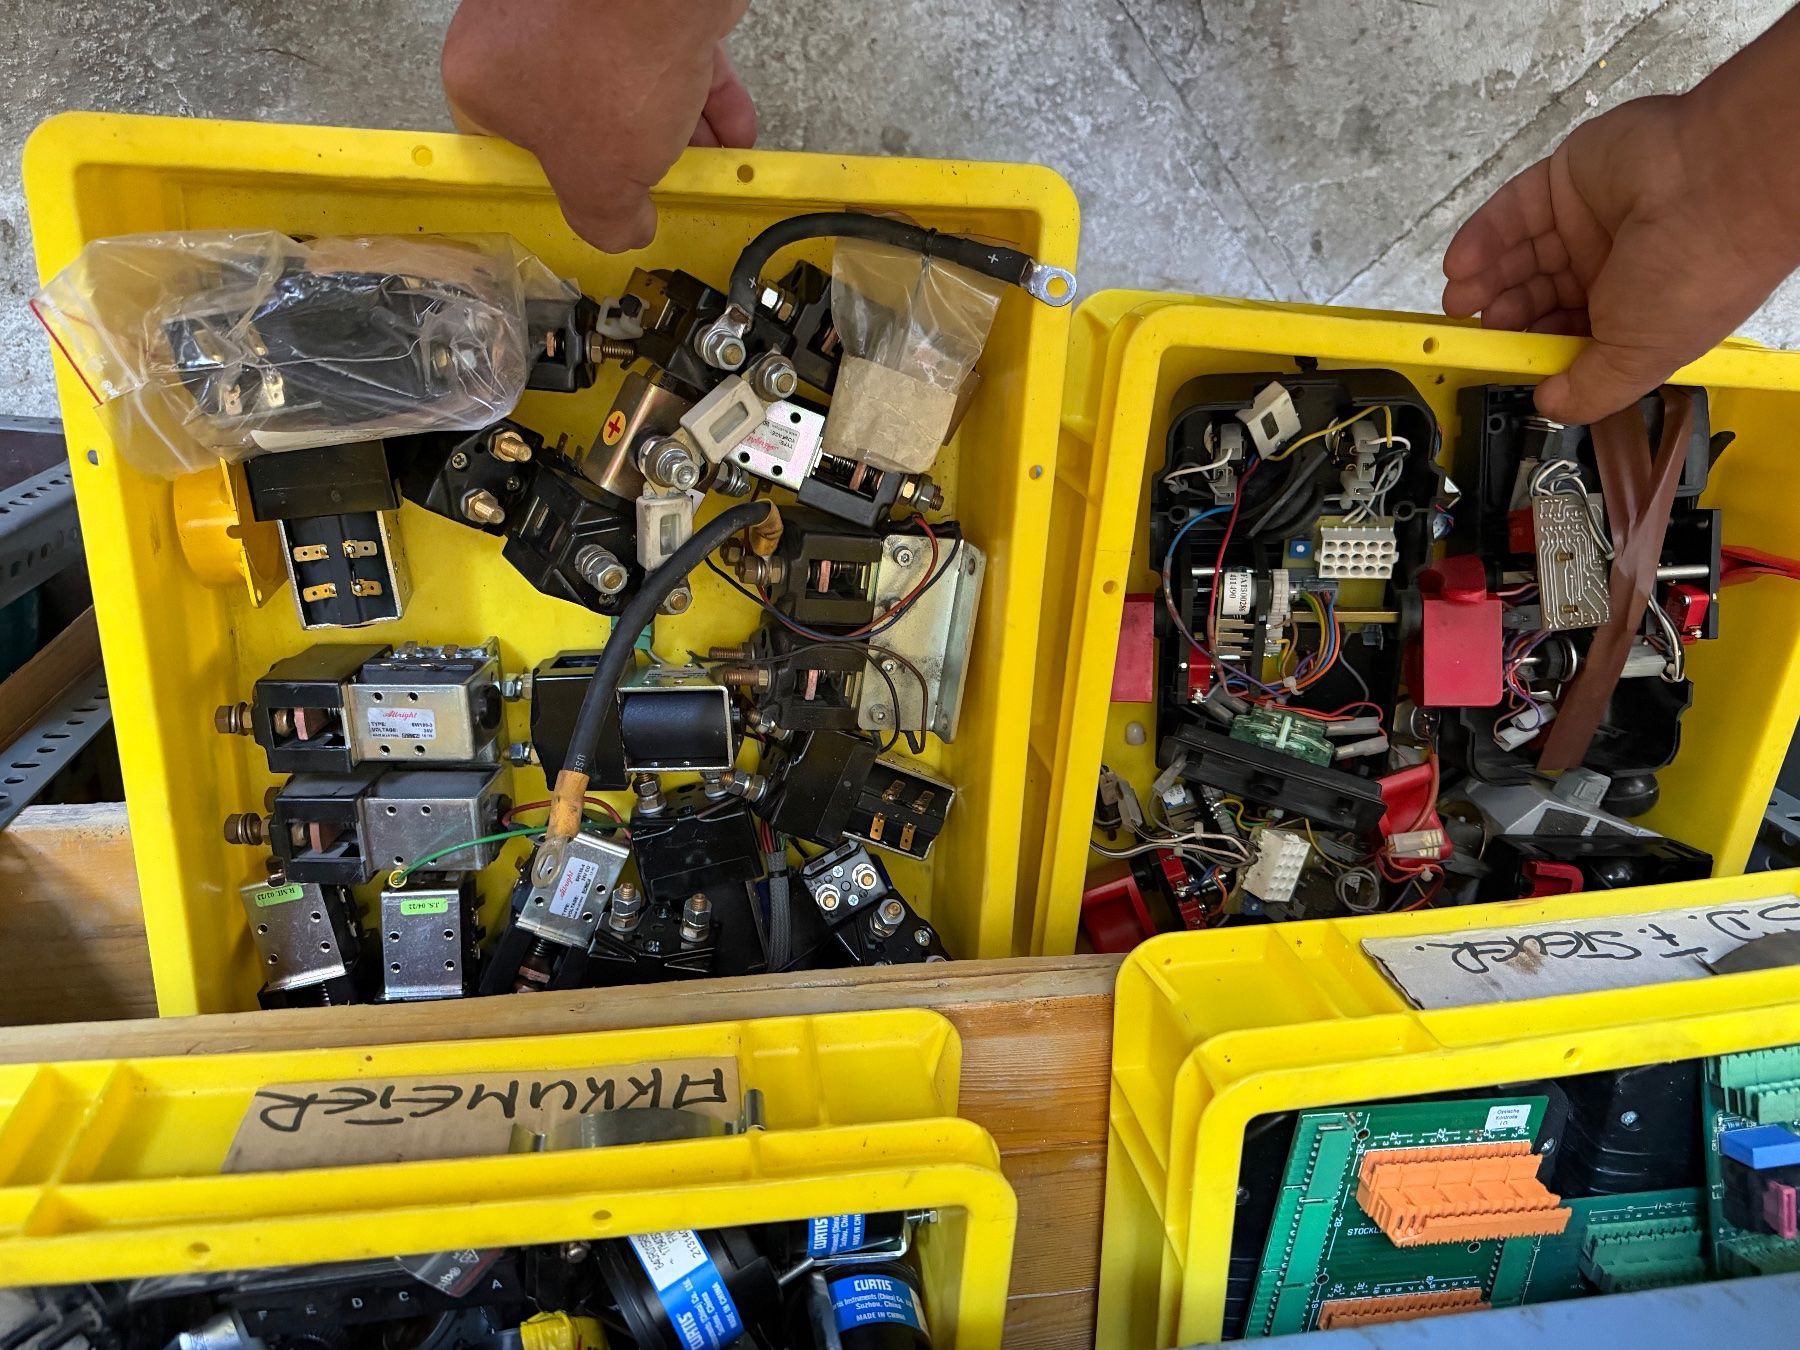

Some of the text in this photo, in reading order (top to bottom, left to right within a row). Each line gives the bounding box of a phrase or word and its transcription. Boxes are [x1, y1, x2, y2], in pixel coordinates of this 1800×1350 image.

[255, 1067, 728, 1133] AKKUMETER
[853, 1278, 893, 1292] CURTIS
[399, 1290, 410, 1302] C
[351, 1297, 363, 1309] D
